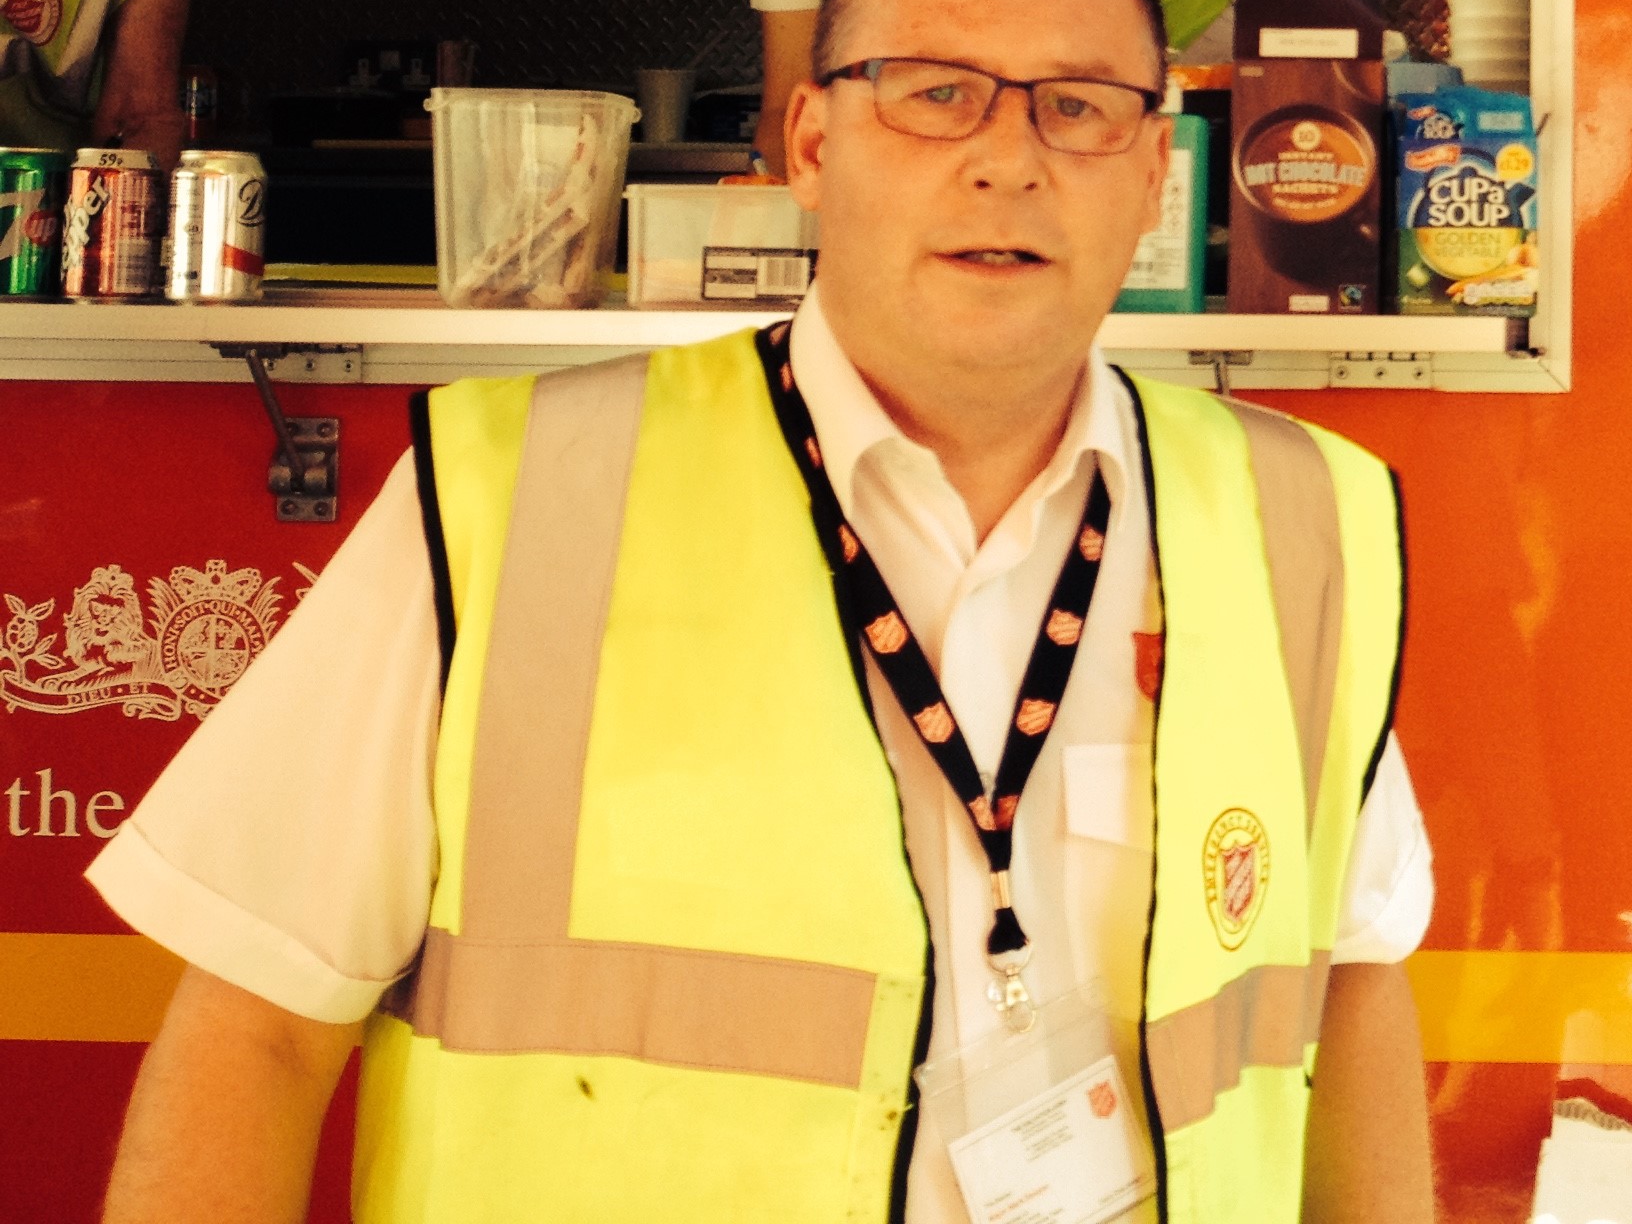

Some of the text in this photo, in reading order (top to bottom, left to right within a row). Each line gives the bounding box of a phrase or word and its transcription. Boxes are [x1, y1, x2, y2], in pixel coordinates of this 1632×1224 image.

[1427, 203, 1511, 227] SOUP
[1434, 231, 1501, 245] GOLDEN
[176, 602, 206, 628] SOIT
[209, 600, 238, 617] QUI
[66, 682, 150, 706] DIEU ET
[4, 767, 125, 839] the
